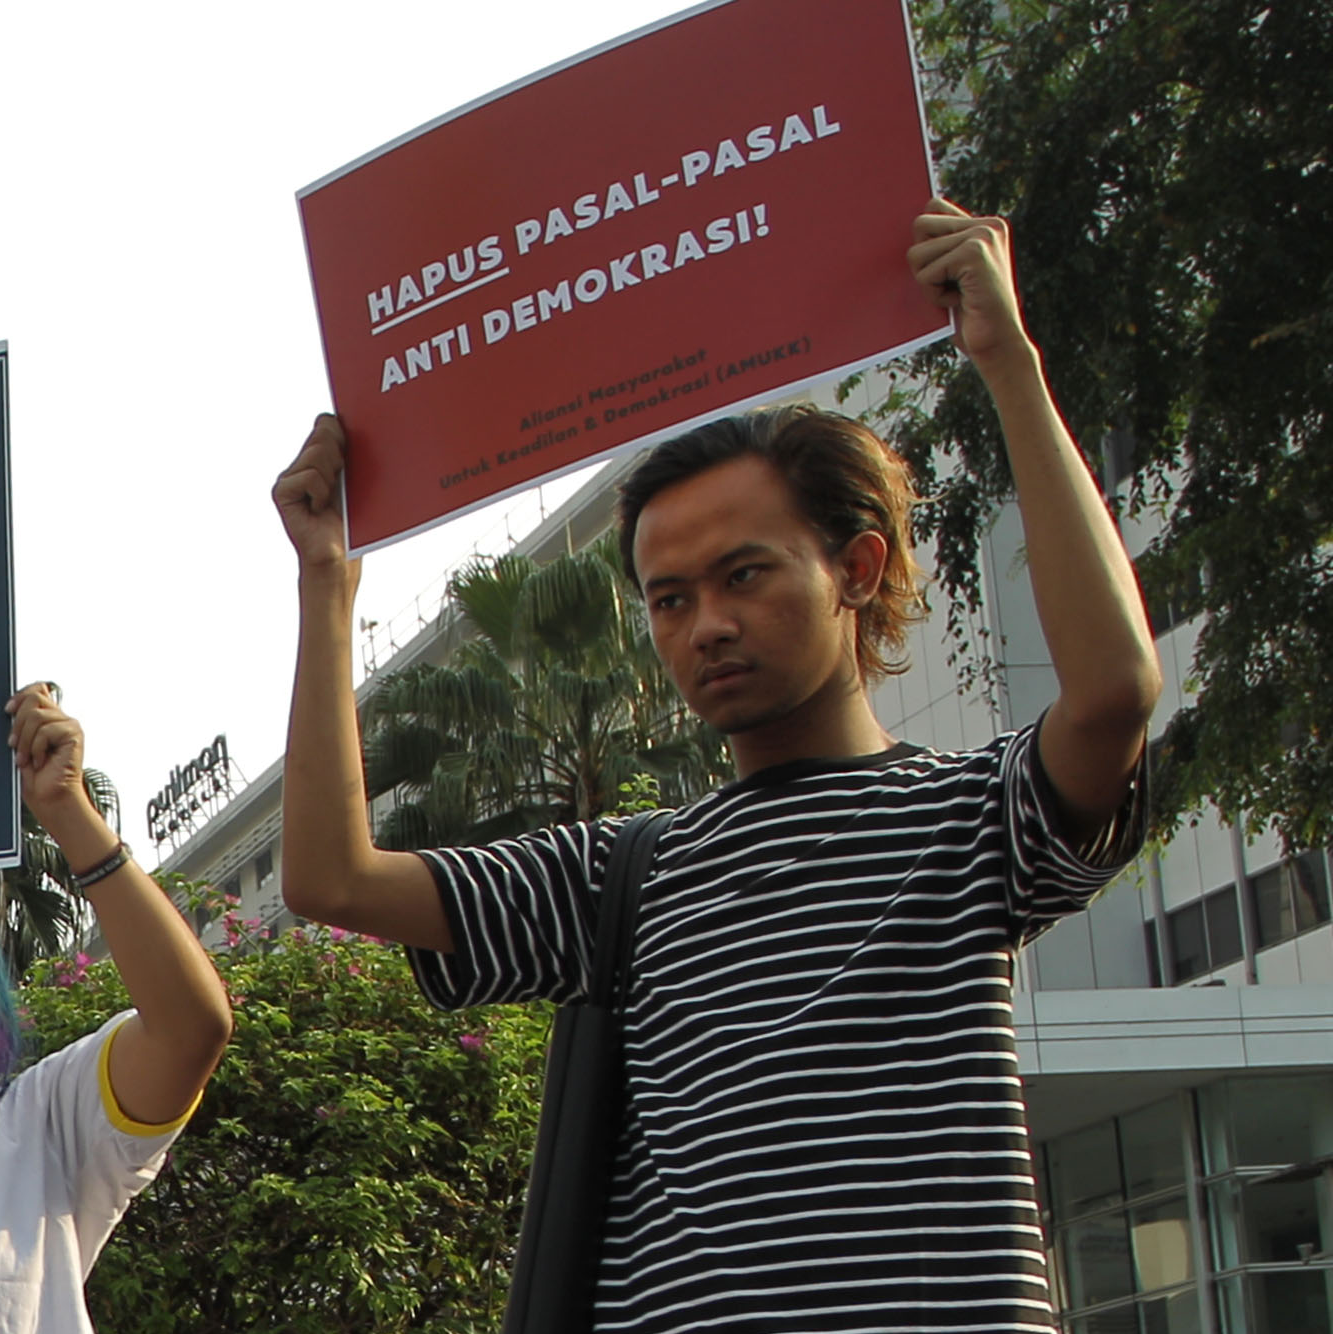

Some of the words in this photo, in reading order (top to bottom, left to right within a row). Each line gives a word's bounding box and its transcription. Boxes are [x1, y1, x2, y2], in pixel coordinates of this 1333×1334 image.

[367, 235, 504, 325] HAPUS
[515, 104, 841, 256] PASAL-PASAL
[380, 323, 471, 393] ANTI
[482, 203, 771, 346] DEMOKRASI!
[439, 458, 491, 490] Untuk
[497, 424, 578, 466] Keadilan
[585, 416, 598, 431] &
[604, 373, 711, 425] Demokrasi
[716, 336, 812, 385] (AMUKK)
[519, 393, 583, 433] Aliansi
[589, 349, 708, 402] Masyarakat
[146, 734, 229, 840] pullman
